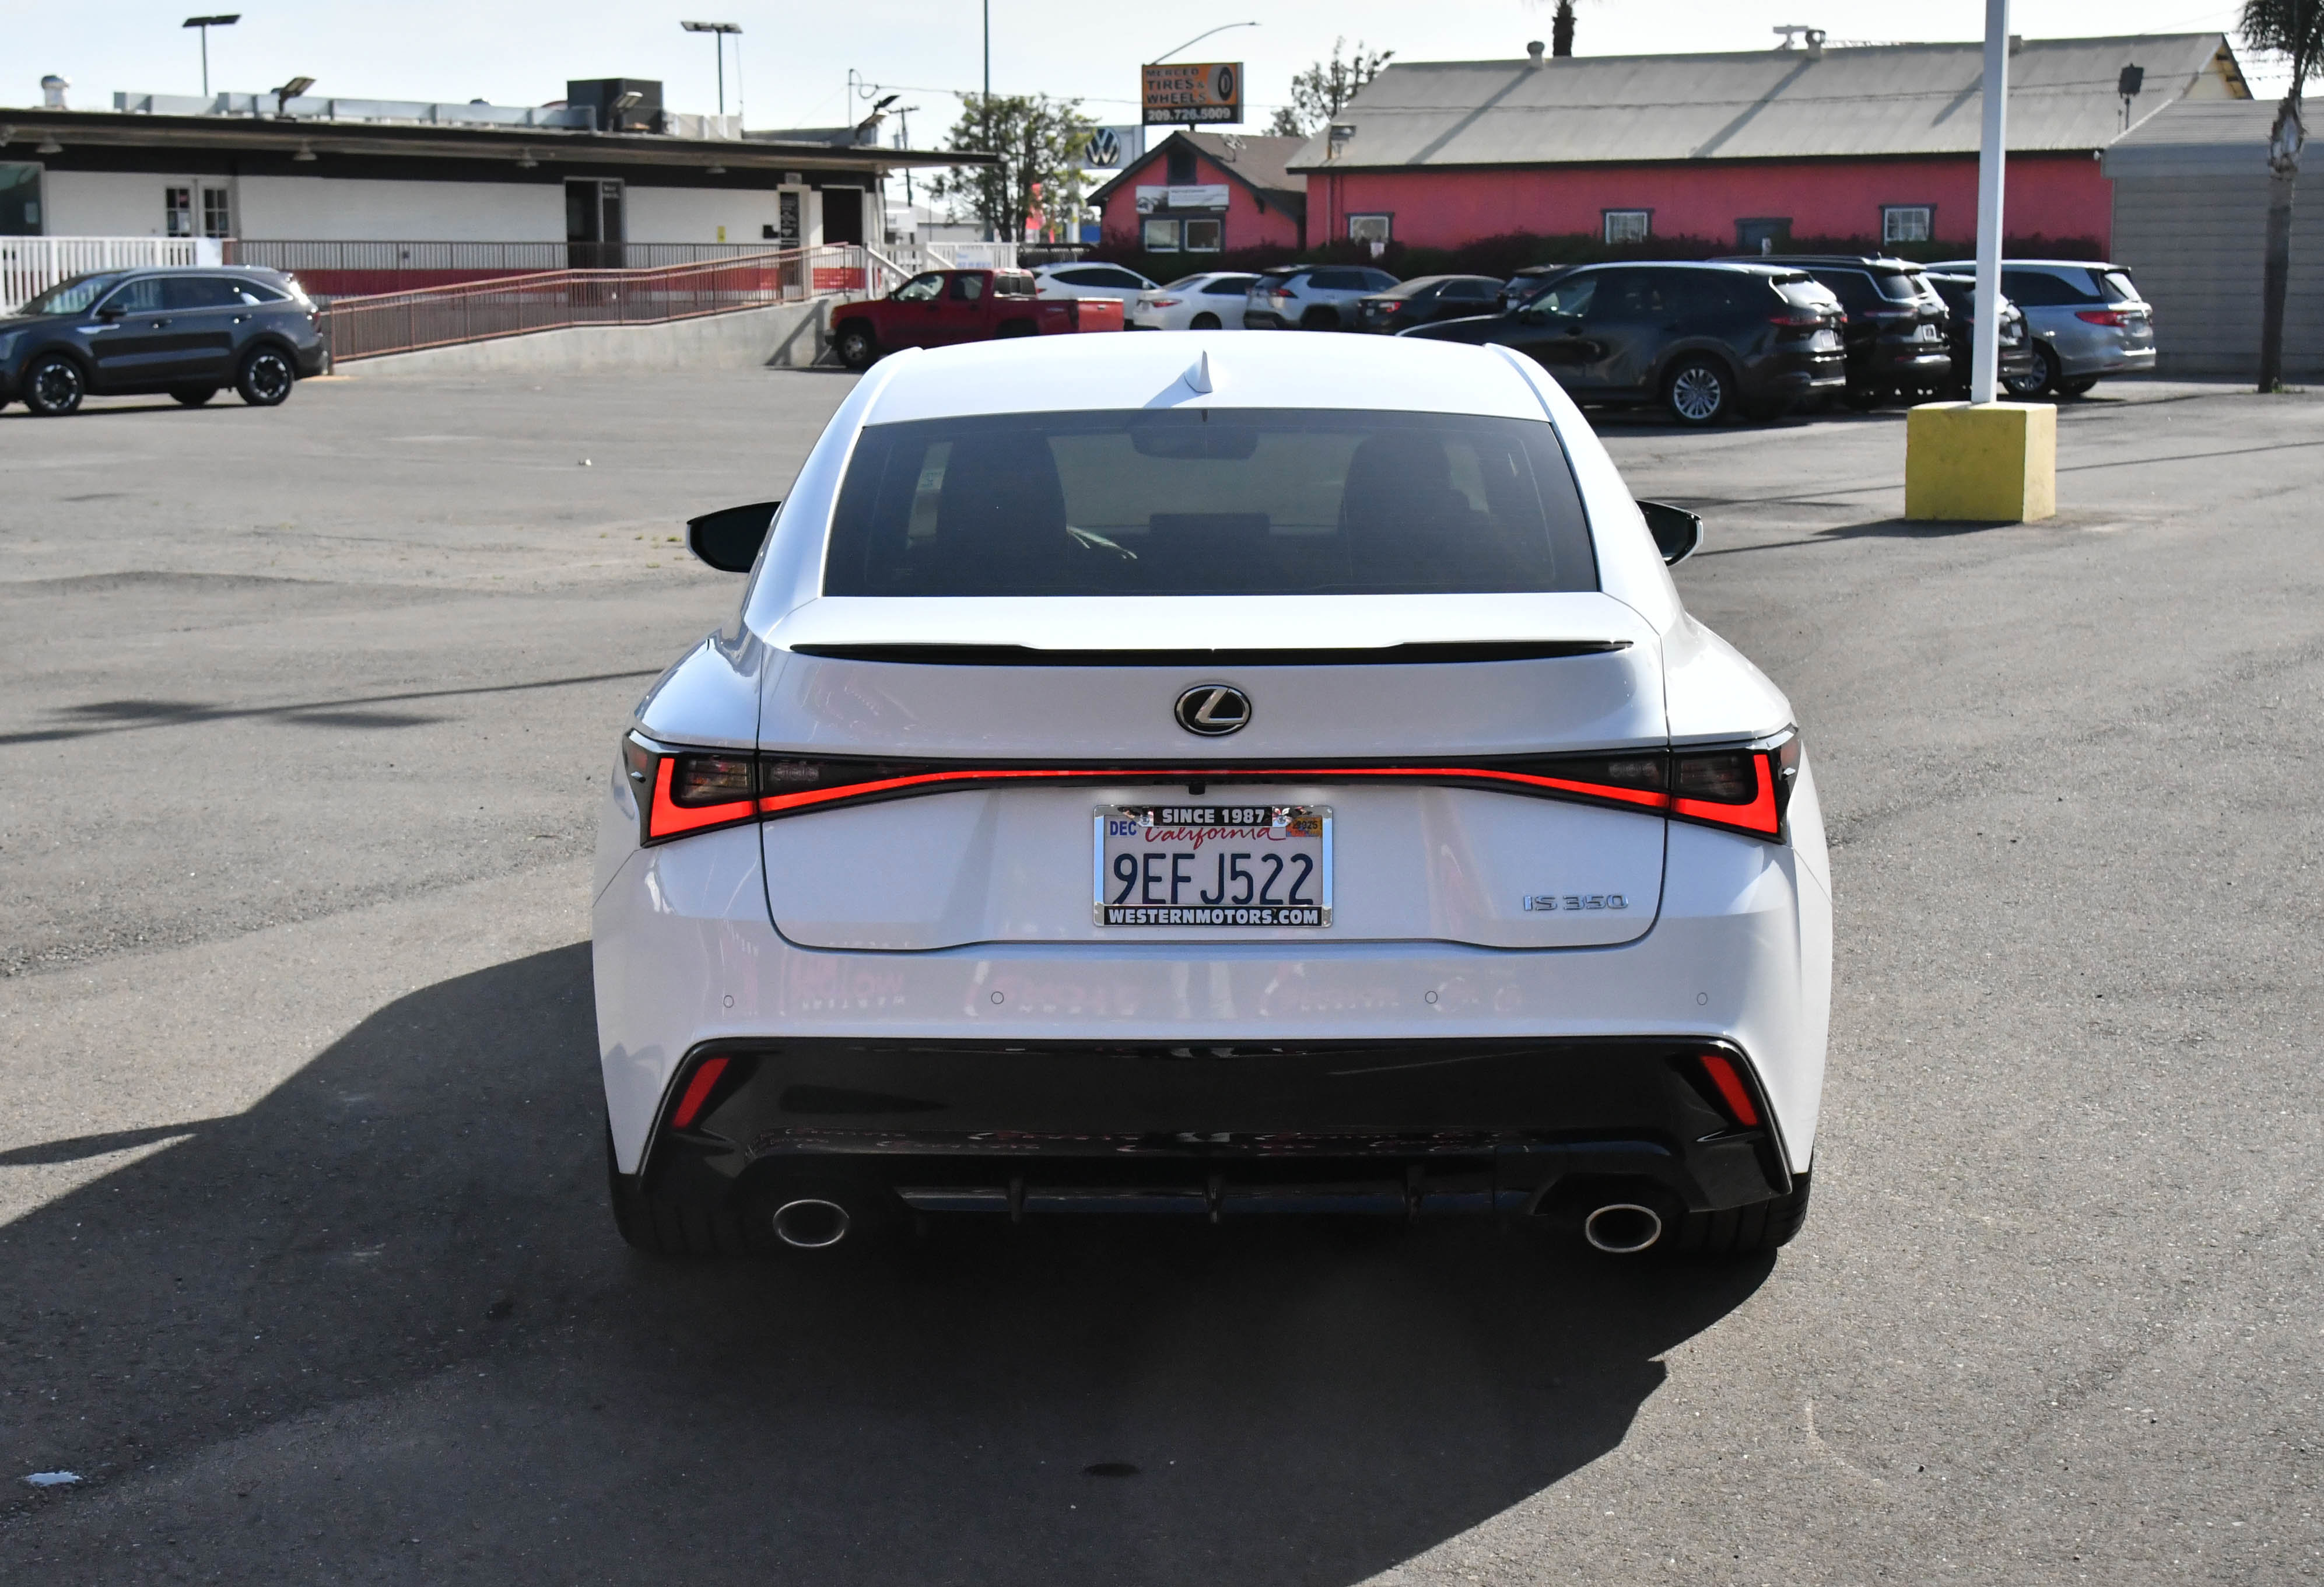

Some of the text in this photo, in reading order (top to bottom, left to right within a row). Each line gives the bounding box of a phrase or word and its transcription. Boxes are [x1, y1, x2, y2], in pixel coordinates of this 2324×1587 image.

[1147, 79, 1194, 90] TIRES
[1147, 92, 1207, 104] WHEELS
[1162, 808, 1265, 824] SINCE 1987
[1110, 821, 1137, 836] DEC
[1145, 827, 1286, 850] California
[1112, 853, 1313, 905] 9EFJ522
[1523, 894, 1629, 911] IS 350
[1108, 909, 1318, 924] WESTERNMOTORS.COM
